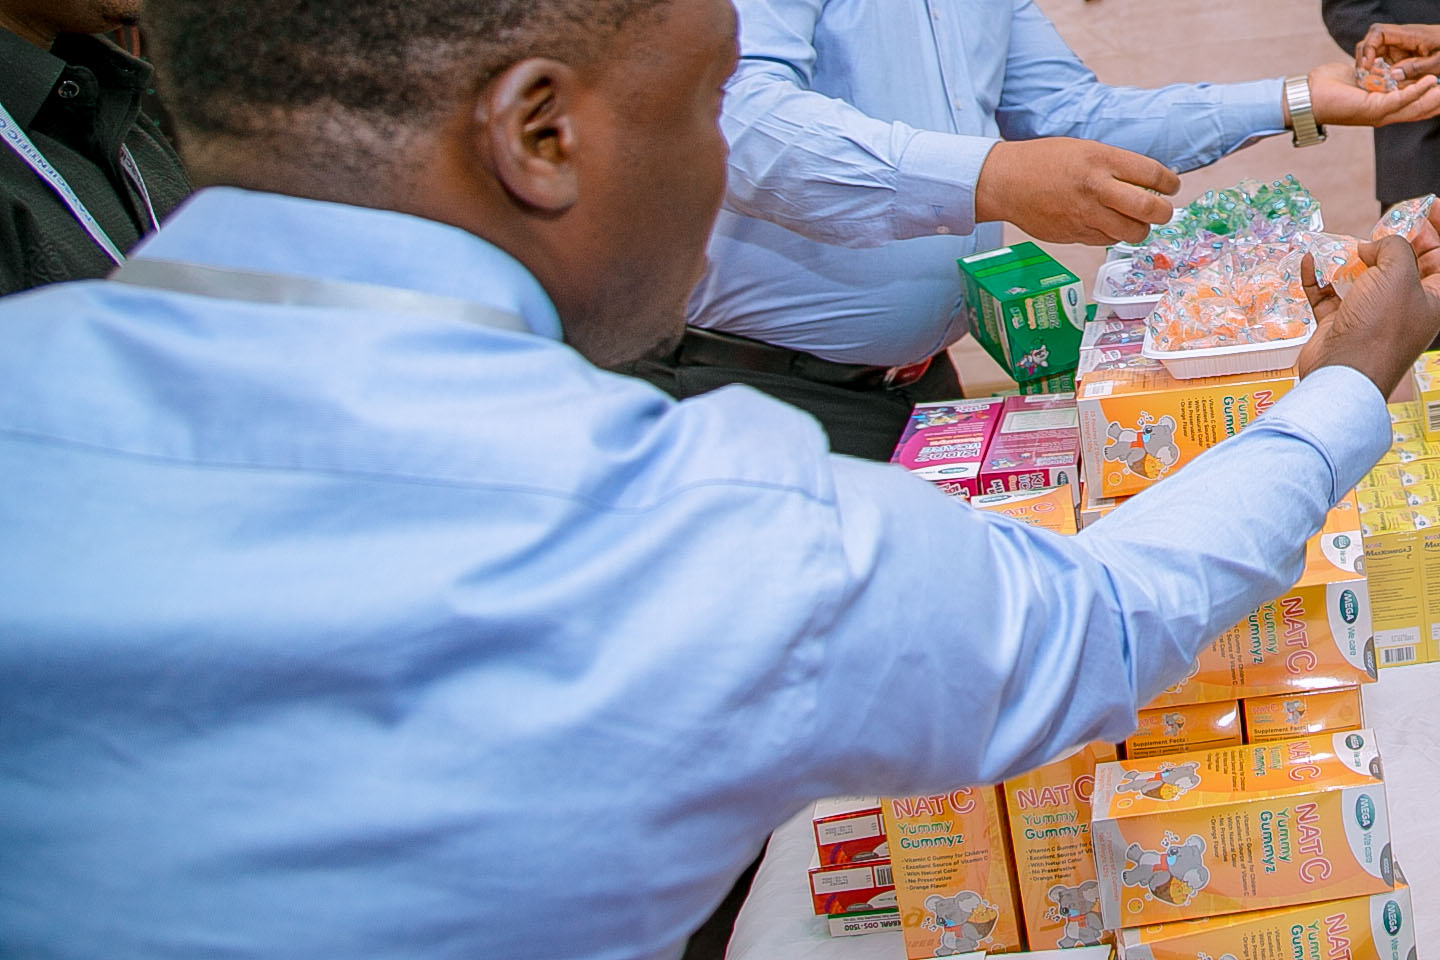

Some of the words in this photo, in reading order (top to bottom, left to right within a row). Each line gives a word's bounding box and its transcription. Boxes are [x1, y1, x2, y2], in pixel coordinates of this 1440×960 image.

[1344, 591, 1355, 622] MEGA
[1264, 601, 1279, 654] Yummy
[1280, 596, 1308, 649] NAT
[1286, 650, 1318, 674] C
[1132, 737, 1169, 747] Supplement
[1170, 736, 1186, 744] Facts
[1254, 727, 1289, 735] Supplement
[891, 792, 948, 819] NAT
[948, 787, 975, 814] C
[1016, 783, 1072, 809] NAT
[1022, 810, 1079, 826] Yummy
[1359, 797, 1371, 827] MEGA
[896, 820, 953, 835] Yummy
[899, 833, 965, 849] Gummyz
[1024, 823, 1089, 840] Gummyz
[1276, 808, 1293, 862] Yummy
[1295, 802, 1323, 855] NAT
[1260, 810, 1276, 875] Gummyz
[1299, 857, 1332, 884] C
[1386, 902, 1399, 934] MEGA
